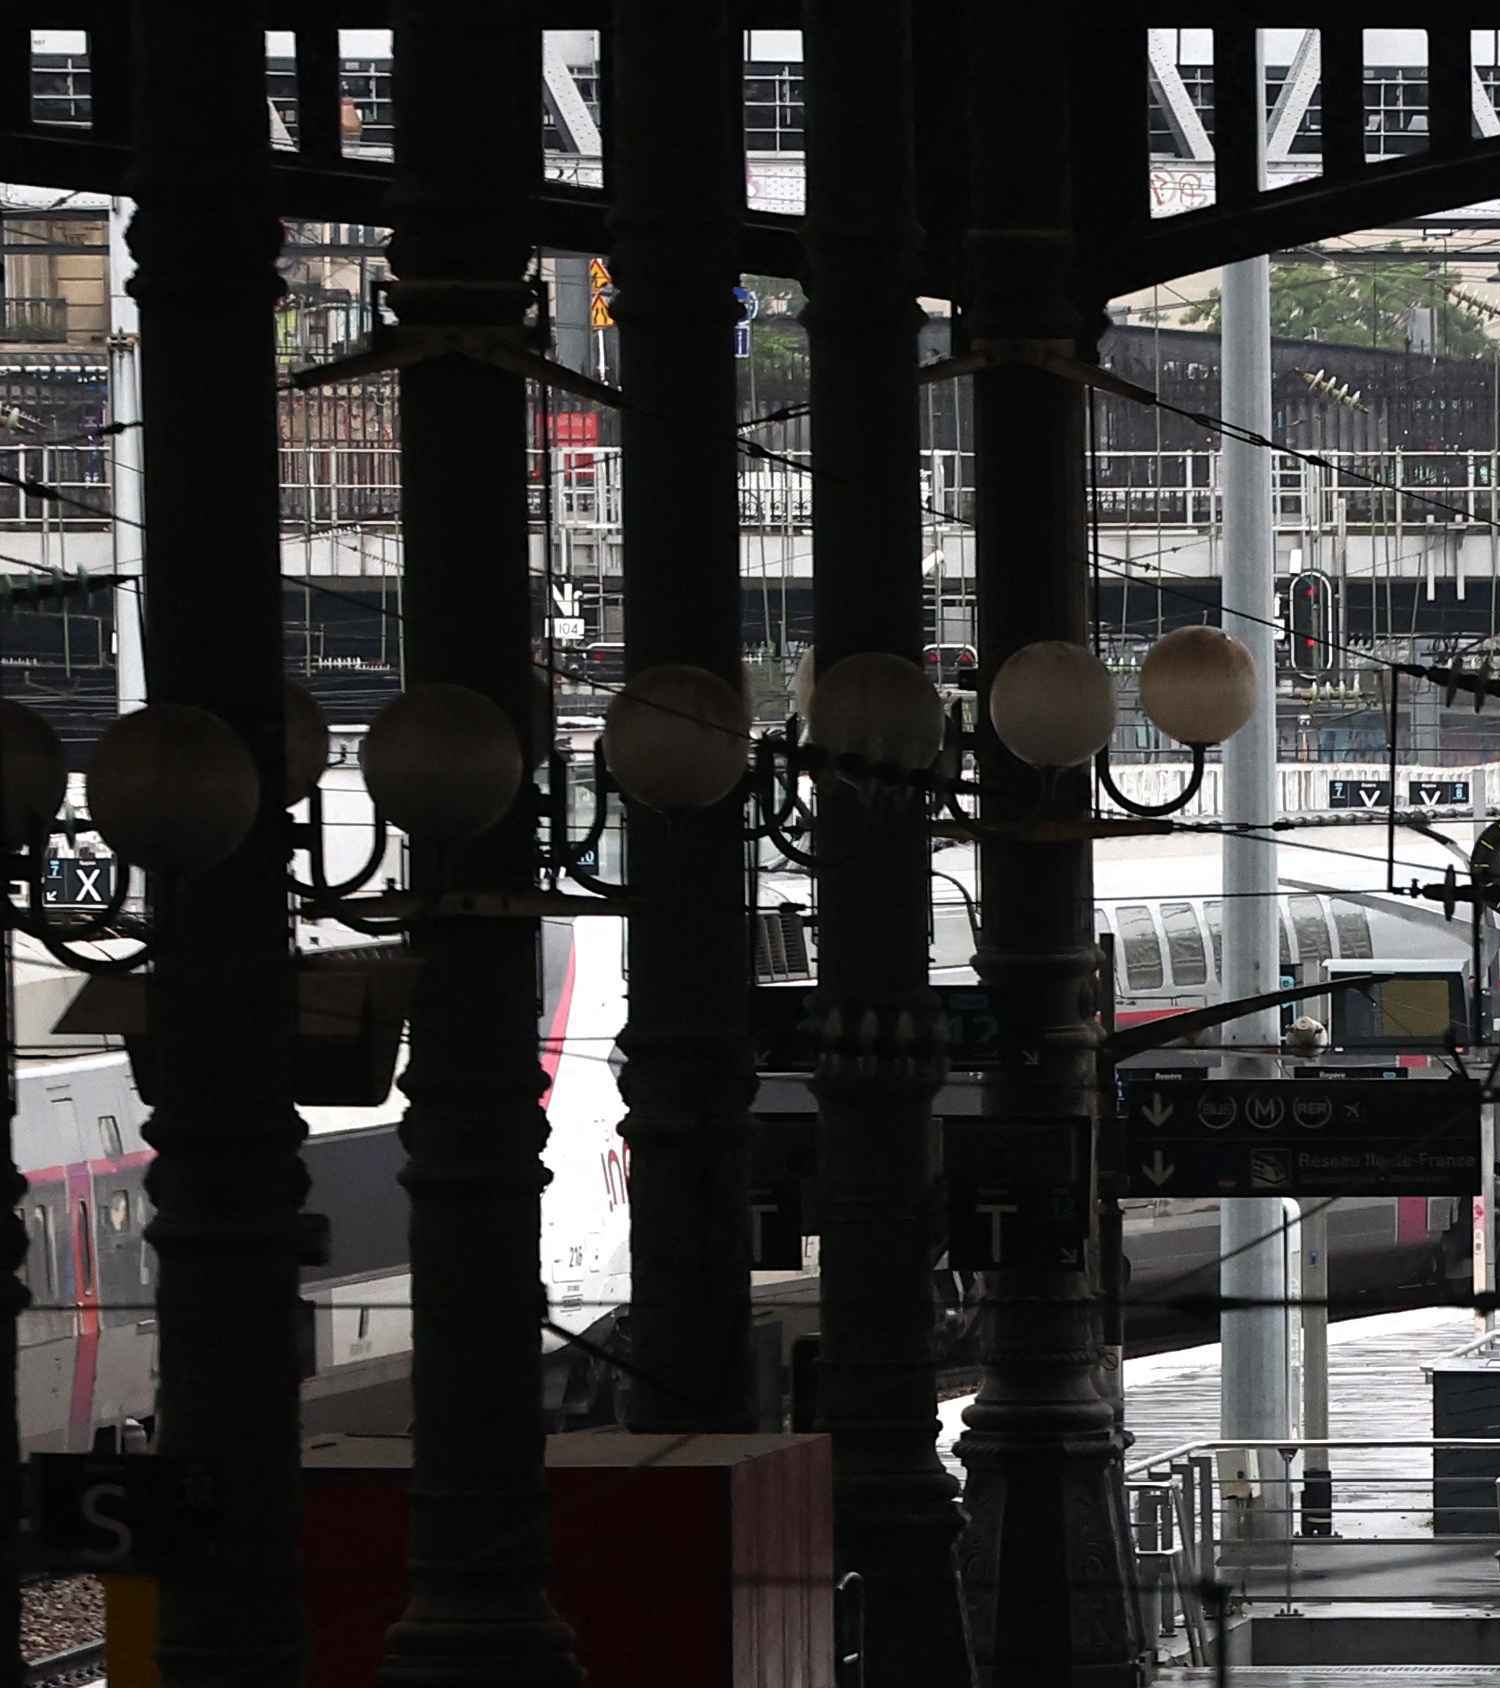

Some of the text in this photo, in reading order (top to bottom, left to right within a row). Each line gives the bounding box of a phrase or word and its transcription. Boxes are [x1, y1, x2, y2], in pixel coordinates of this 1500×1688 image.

[1359, 790, 1381, 808] V
[1419, 790, 1441, 806] V
[76, 869, 102, 901] X
[82, 1482, 132, 1560] S
